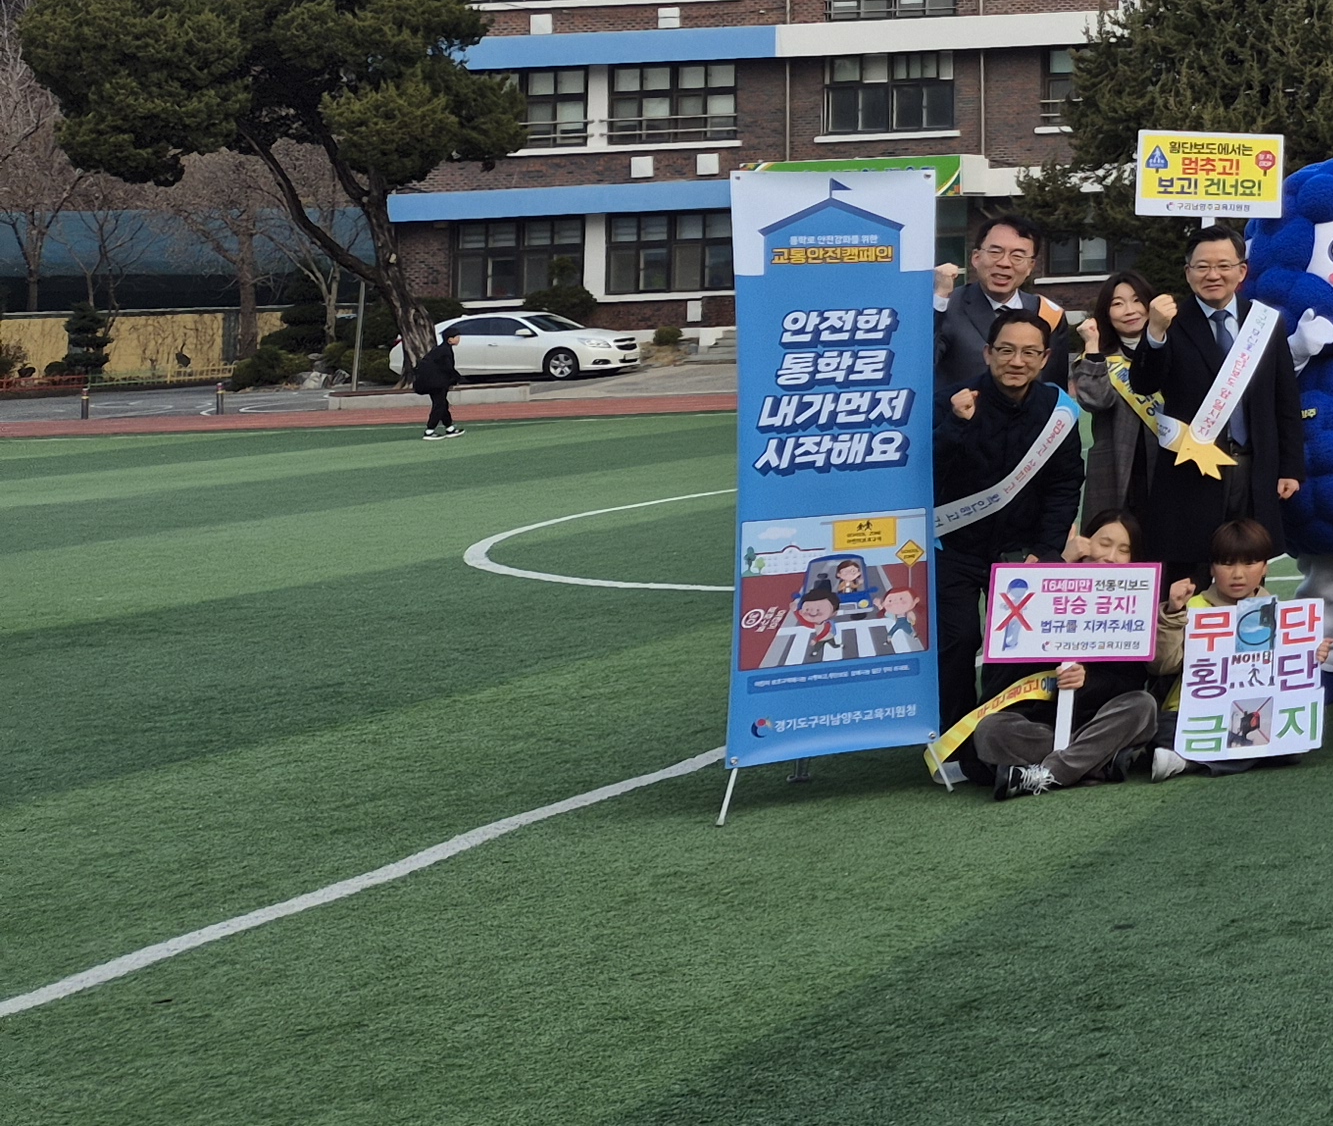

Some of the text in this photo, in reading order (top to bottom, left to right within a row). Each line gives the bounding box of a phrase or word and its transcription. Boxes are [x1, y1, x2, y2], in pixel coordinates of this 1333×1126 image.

[1169, 141, 1253, 156] 횡단보도에서는
[1181, 157, 1240, 176] 멈추고!
[1157, 177, 1262, 196] 보고! 건너요!
[861, 234, 878, 244] 위한
[771, 245, 893, 265] 교통안전캠페인
[782, 308, 896, 347] 안전한
[776, 348, 893, 389] 통학로
[758, 389, 913, 431] 내가먼저
[755, 431, 907, 475] 시작해요
[1042, 580, 1149, 593] 16세미만 전동킥보드
[1053, 595, 1137, 615] 탑승 금지!
[1041, 619, 1145, 633] 법규를 지켜주세요
[1055, 641, 1140, 650] 구리남양주교육지원청
[774, 705, 917, 733] 경기도구리남양주교육지원청
